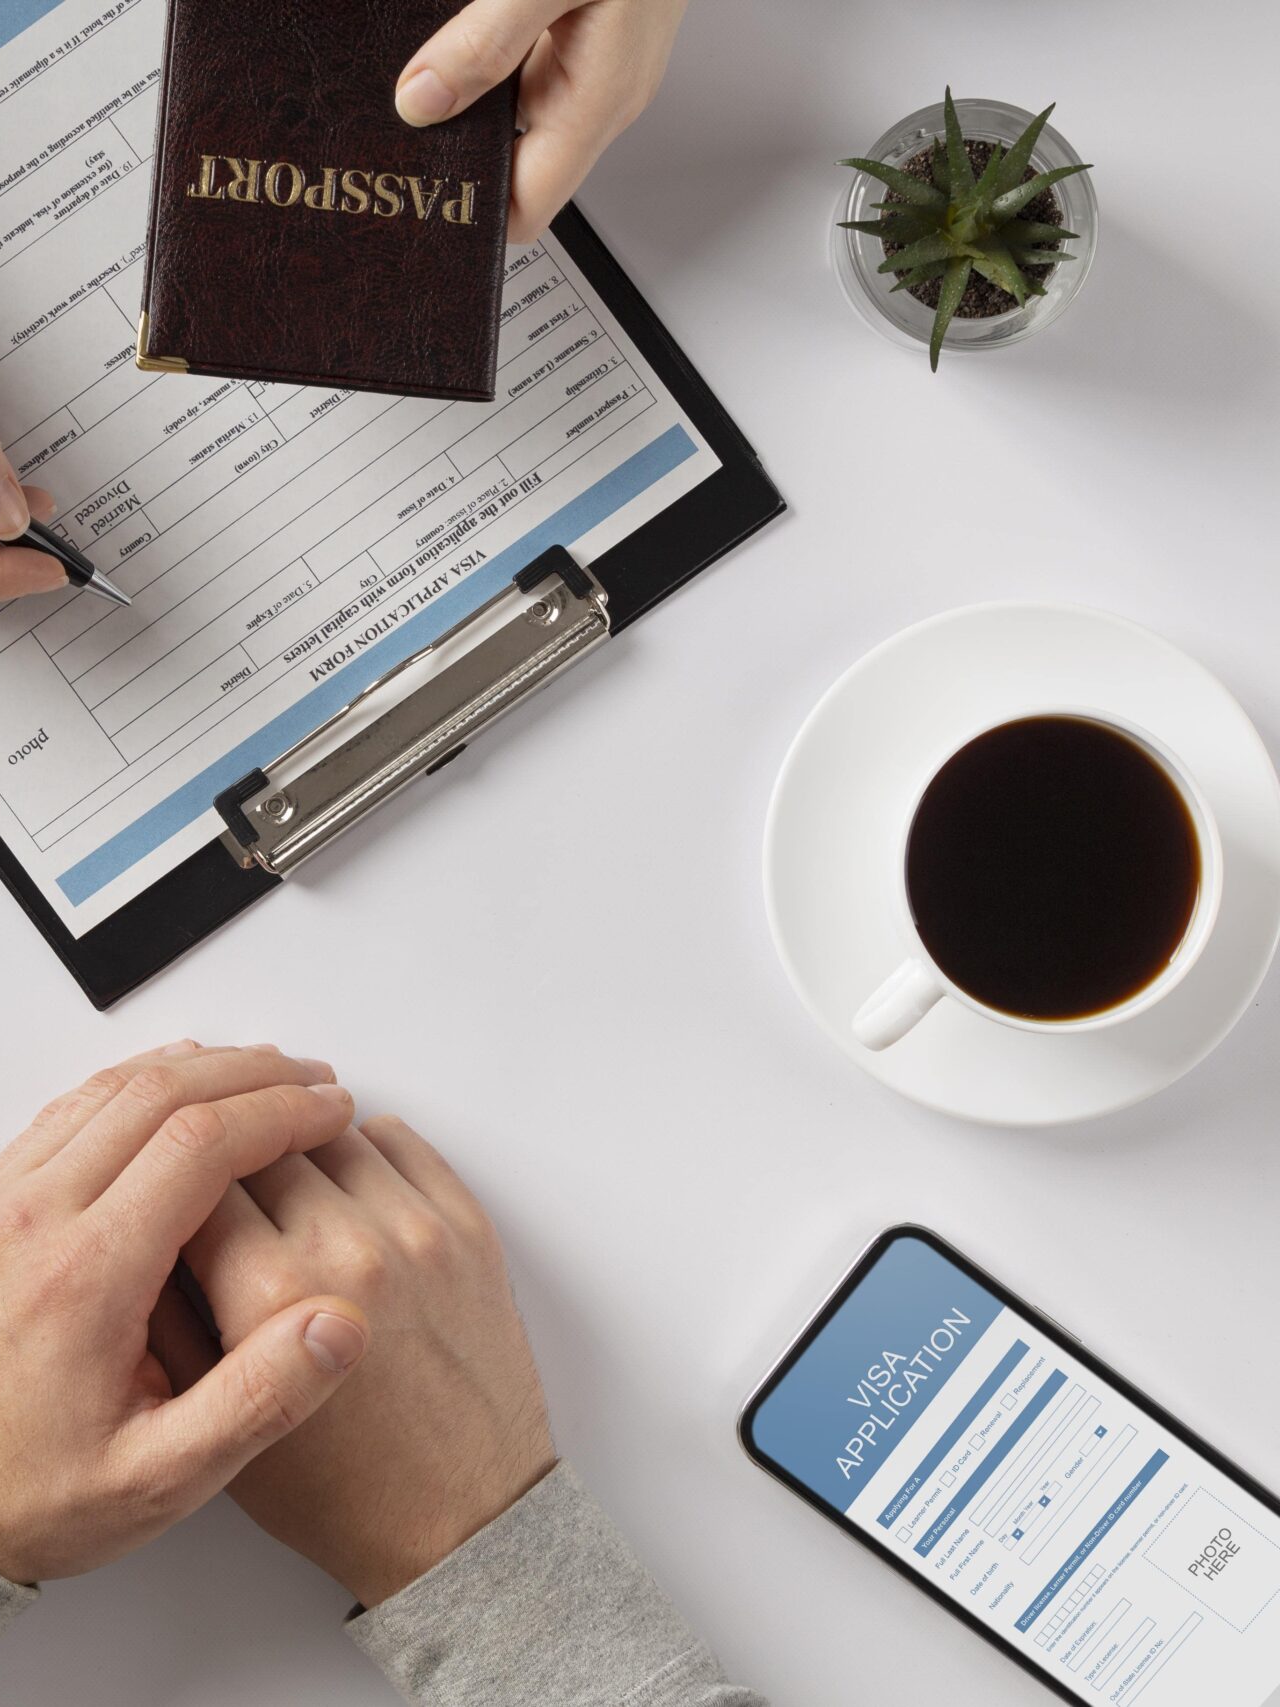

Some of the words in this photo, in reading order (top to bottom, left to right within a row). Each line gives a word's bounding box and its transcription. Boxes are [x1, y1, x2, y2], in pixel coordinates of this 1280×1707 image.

[100, 7, 116, 21] the
[114, 1, 125, 14] of
[78, 17, 104, 38] hotel.
[54, 45, 65, 55] is
[62, 39, 73, 50] it
[70, 33, 81, 46] If
[47, 50, 56, 60] a
[7, 56, 49, 89] diplomatic
[119, 88, 134, 100] be
[129, 78, 147, 95] will
[84, 96, 123, 128] identified
[45, 122, 86, 153] according
[24, 156, 40, 170] the
[38, 149, 49, 160] to
[83, 149, 106, 169] stay)
[96, 158, 113, 174] (for
[118, 159, 133, 172] 19.
[59, 170, 97, 200] extension
[98, 168, 121, 187] Date
[89, 183, 100, 197] of
[185, 153, 481, 225] PASSPORT
[31, 204, 52, 219] visa,
[50, 196, 61, 210] of
[52, 190, 91, 221] departure
[1, 216, 35, 243] indicate
[507, 253, 531, 272] Date
[527, 247, 539, 257] 9.
[85, 261, 123, 289] Describe
[547, 274, 559, 285] 8.
[67, 283, 87, 303] your
[519, 280, 551, 305] Middle
[46, 300, 69, 318] work
[547, 307, 571, 327] First
[567, 302, 579, 312] 7.
[9, 313, 49, 345] (activity):
[526, 321, 550, 341] name
[589, 328, 598, 339] 6.
[552, 334, 590, 363] Surname
[530, 359, 555, 380] (Last
[606, 355, 618, 365] 3.
[506, 375, 534, 398] name)
[564, 362, 609, 396] Citizenship
[626, 382, 641, 395] 1.
[197, 381, 231, 407] number,
[592, 388, 630, 418] Passport
[185, 405, 200, 417] zip
[308, 392, 341, 419] District
[161, 414, 187, 435] code):
[246, 411, 259, 424] 13.
[564, 413, 599, 439] number
[47, 427, 78, 453] E-mail
[213, 420, 247, 448] Marital
[187, 442, 216, 465] status:
[259, 438, 279, 455] City
[17, 447, 50, 474] address:
[233, 449, 261, 474] (town)
[424, 480, 448, 499] Date
[444, 475, 455, 484] 4.
[497, 477, 509, 487] 2.
[517, 470, 543, 494] Fill
[73, 478, 132, 526] Divorced
[415, 495, 426, 508] of
[475, 483, 501, 503] Place
[497, 487, 519, 507] out
[89, 492, 142, 537] Married
[396, 501, 419, 520] issue
[443, 506, 469, 527] issue:
[465, 500, 477, 514] of
[477, 502, 499, 521] the
[118, 531, 152, 558] Country
[413, 516, 478, 567] application
[414, 523, 445, 549] country
[448, 548, 487, 576] VISA
[301, 578, 313, 590] 5.
[358, 573, 378, 590] City
[385, 562, 417, 588] form
[281, 585, 305, 604] Date
[358, 584, 387, 608] with
[271, 600, 283, 614] of
[352, 571, 449, 650] APPLICATION
[244, 607, 274, 631] Expire
[318, 603, 360, 639] capital
[282, 631, 323, 664] letters
[307, 642, 356, 682] FORM
[219, 665, 252, 692] District
[6, 726, 50, 765] photo
[845, 1350, 907, 1408] VISA
[834, 1306, 971, 1481] APPLICATION
[933, 1556, 947, 1570] Full
[942, 1543, 957, 1559] Last
[951, 1527, 970, 1547] Name
[1186, 1526, 1232, 1577] PHOTO
[948, 1567, 961, 1581] Full
[956, 1554, 972, 1570] First
[967, 1538, 985, 1558] Name
[1201, 1539, 1241, 1581] HERE
